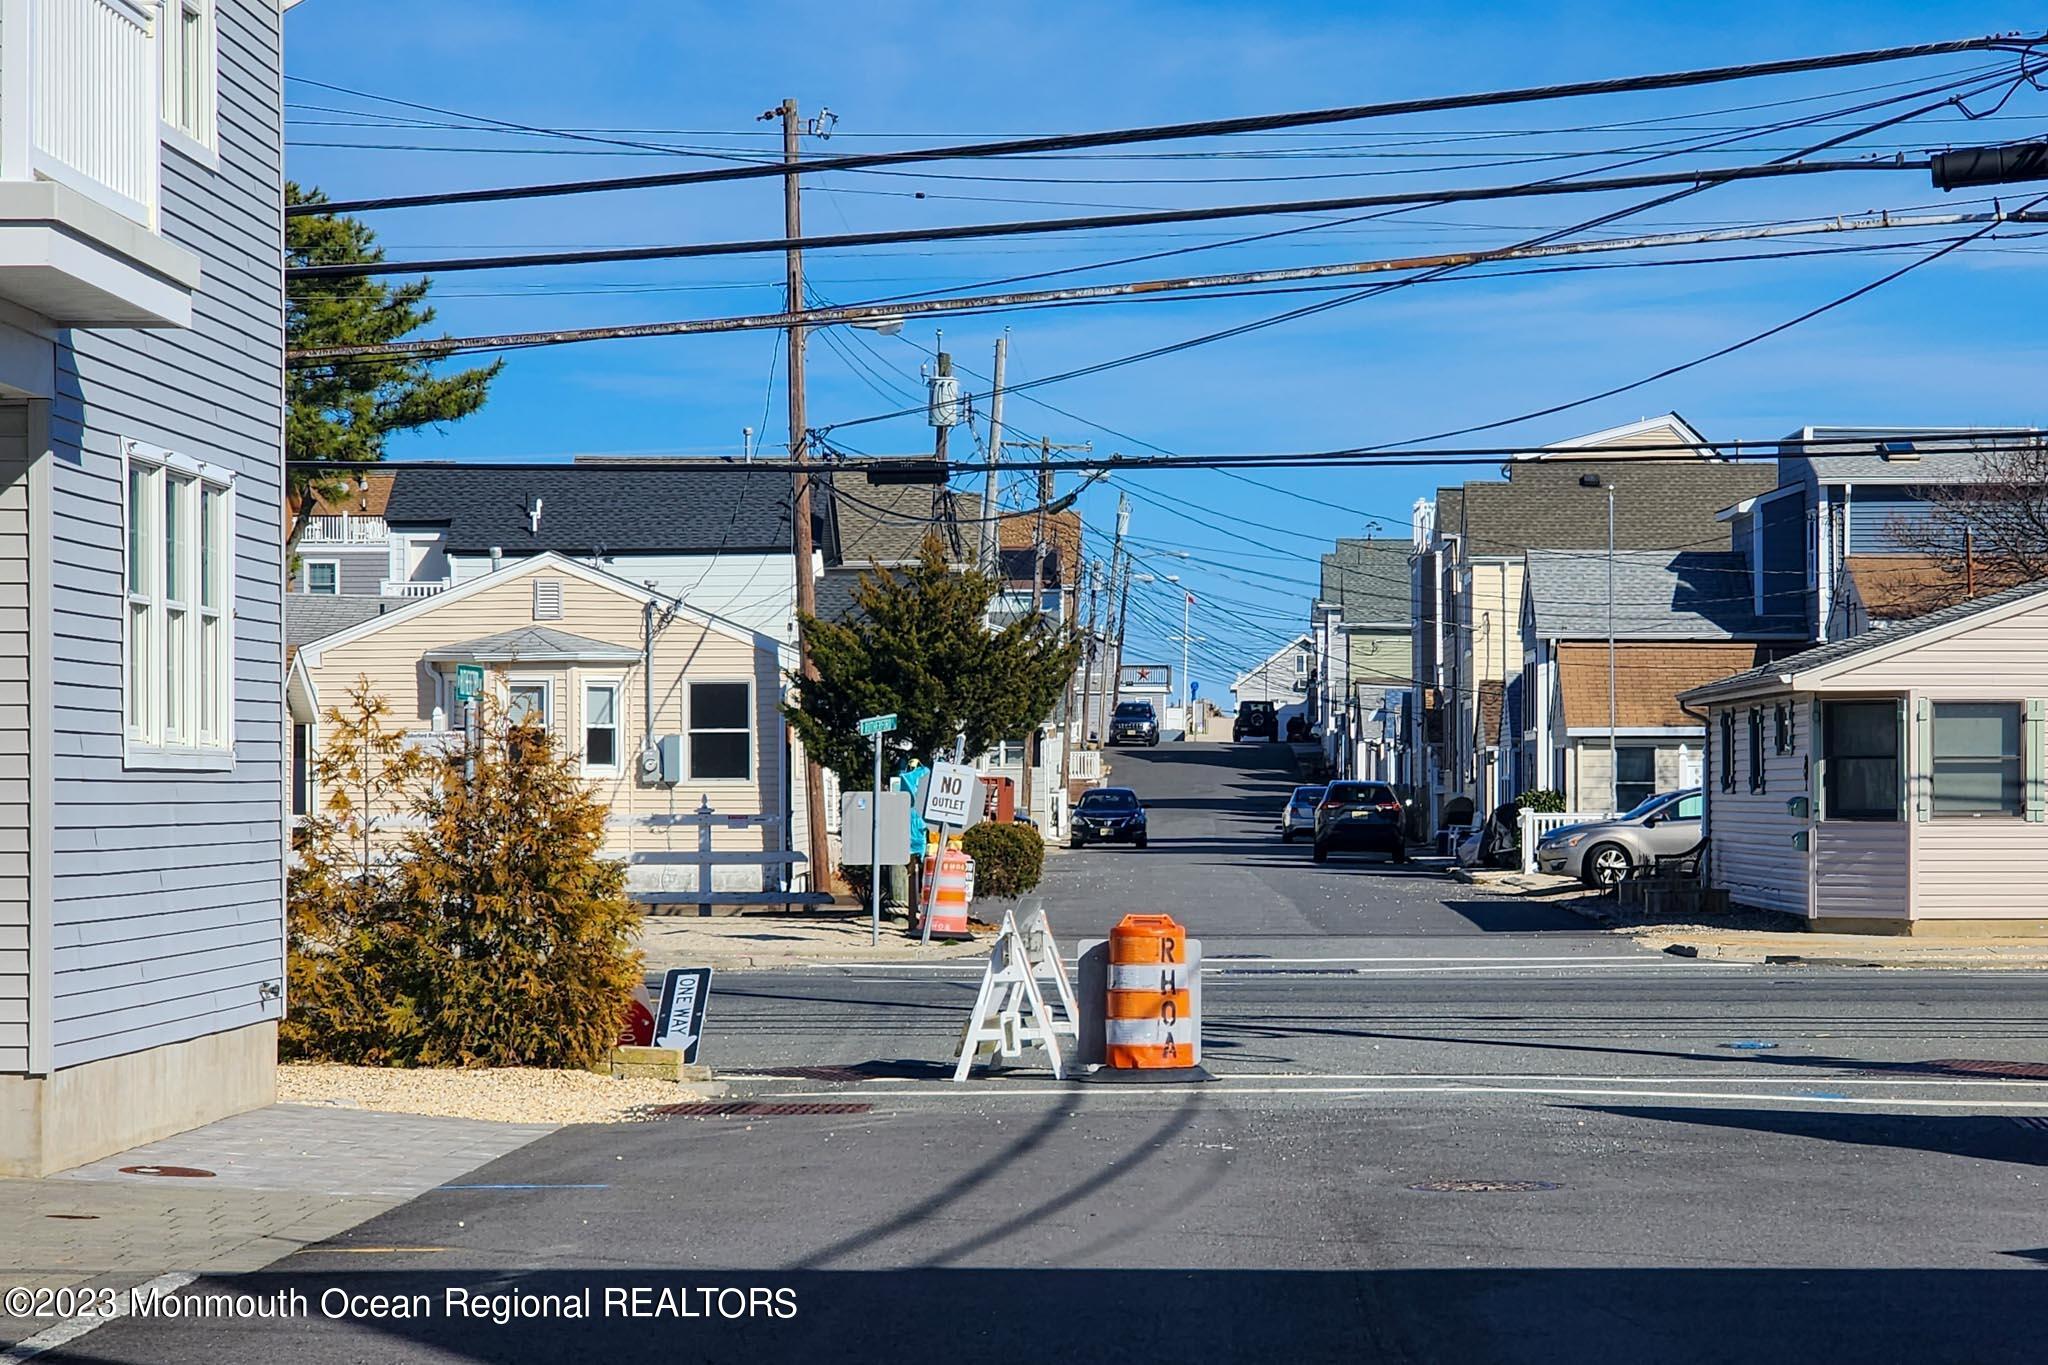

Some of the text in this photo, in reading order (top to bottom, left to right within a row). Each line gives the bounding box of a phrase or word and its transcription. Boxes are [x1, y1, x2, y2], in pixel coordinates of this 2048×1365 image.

[932, 796, 965, 811] OUTLET
[940, 776, 962, 796] NO
[670, 978, 695, 1036] ONE WAY
[1161, 937, 1177, 1059] RHOA
